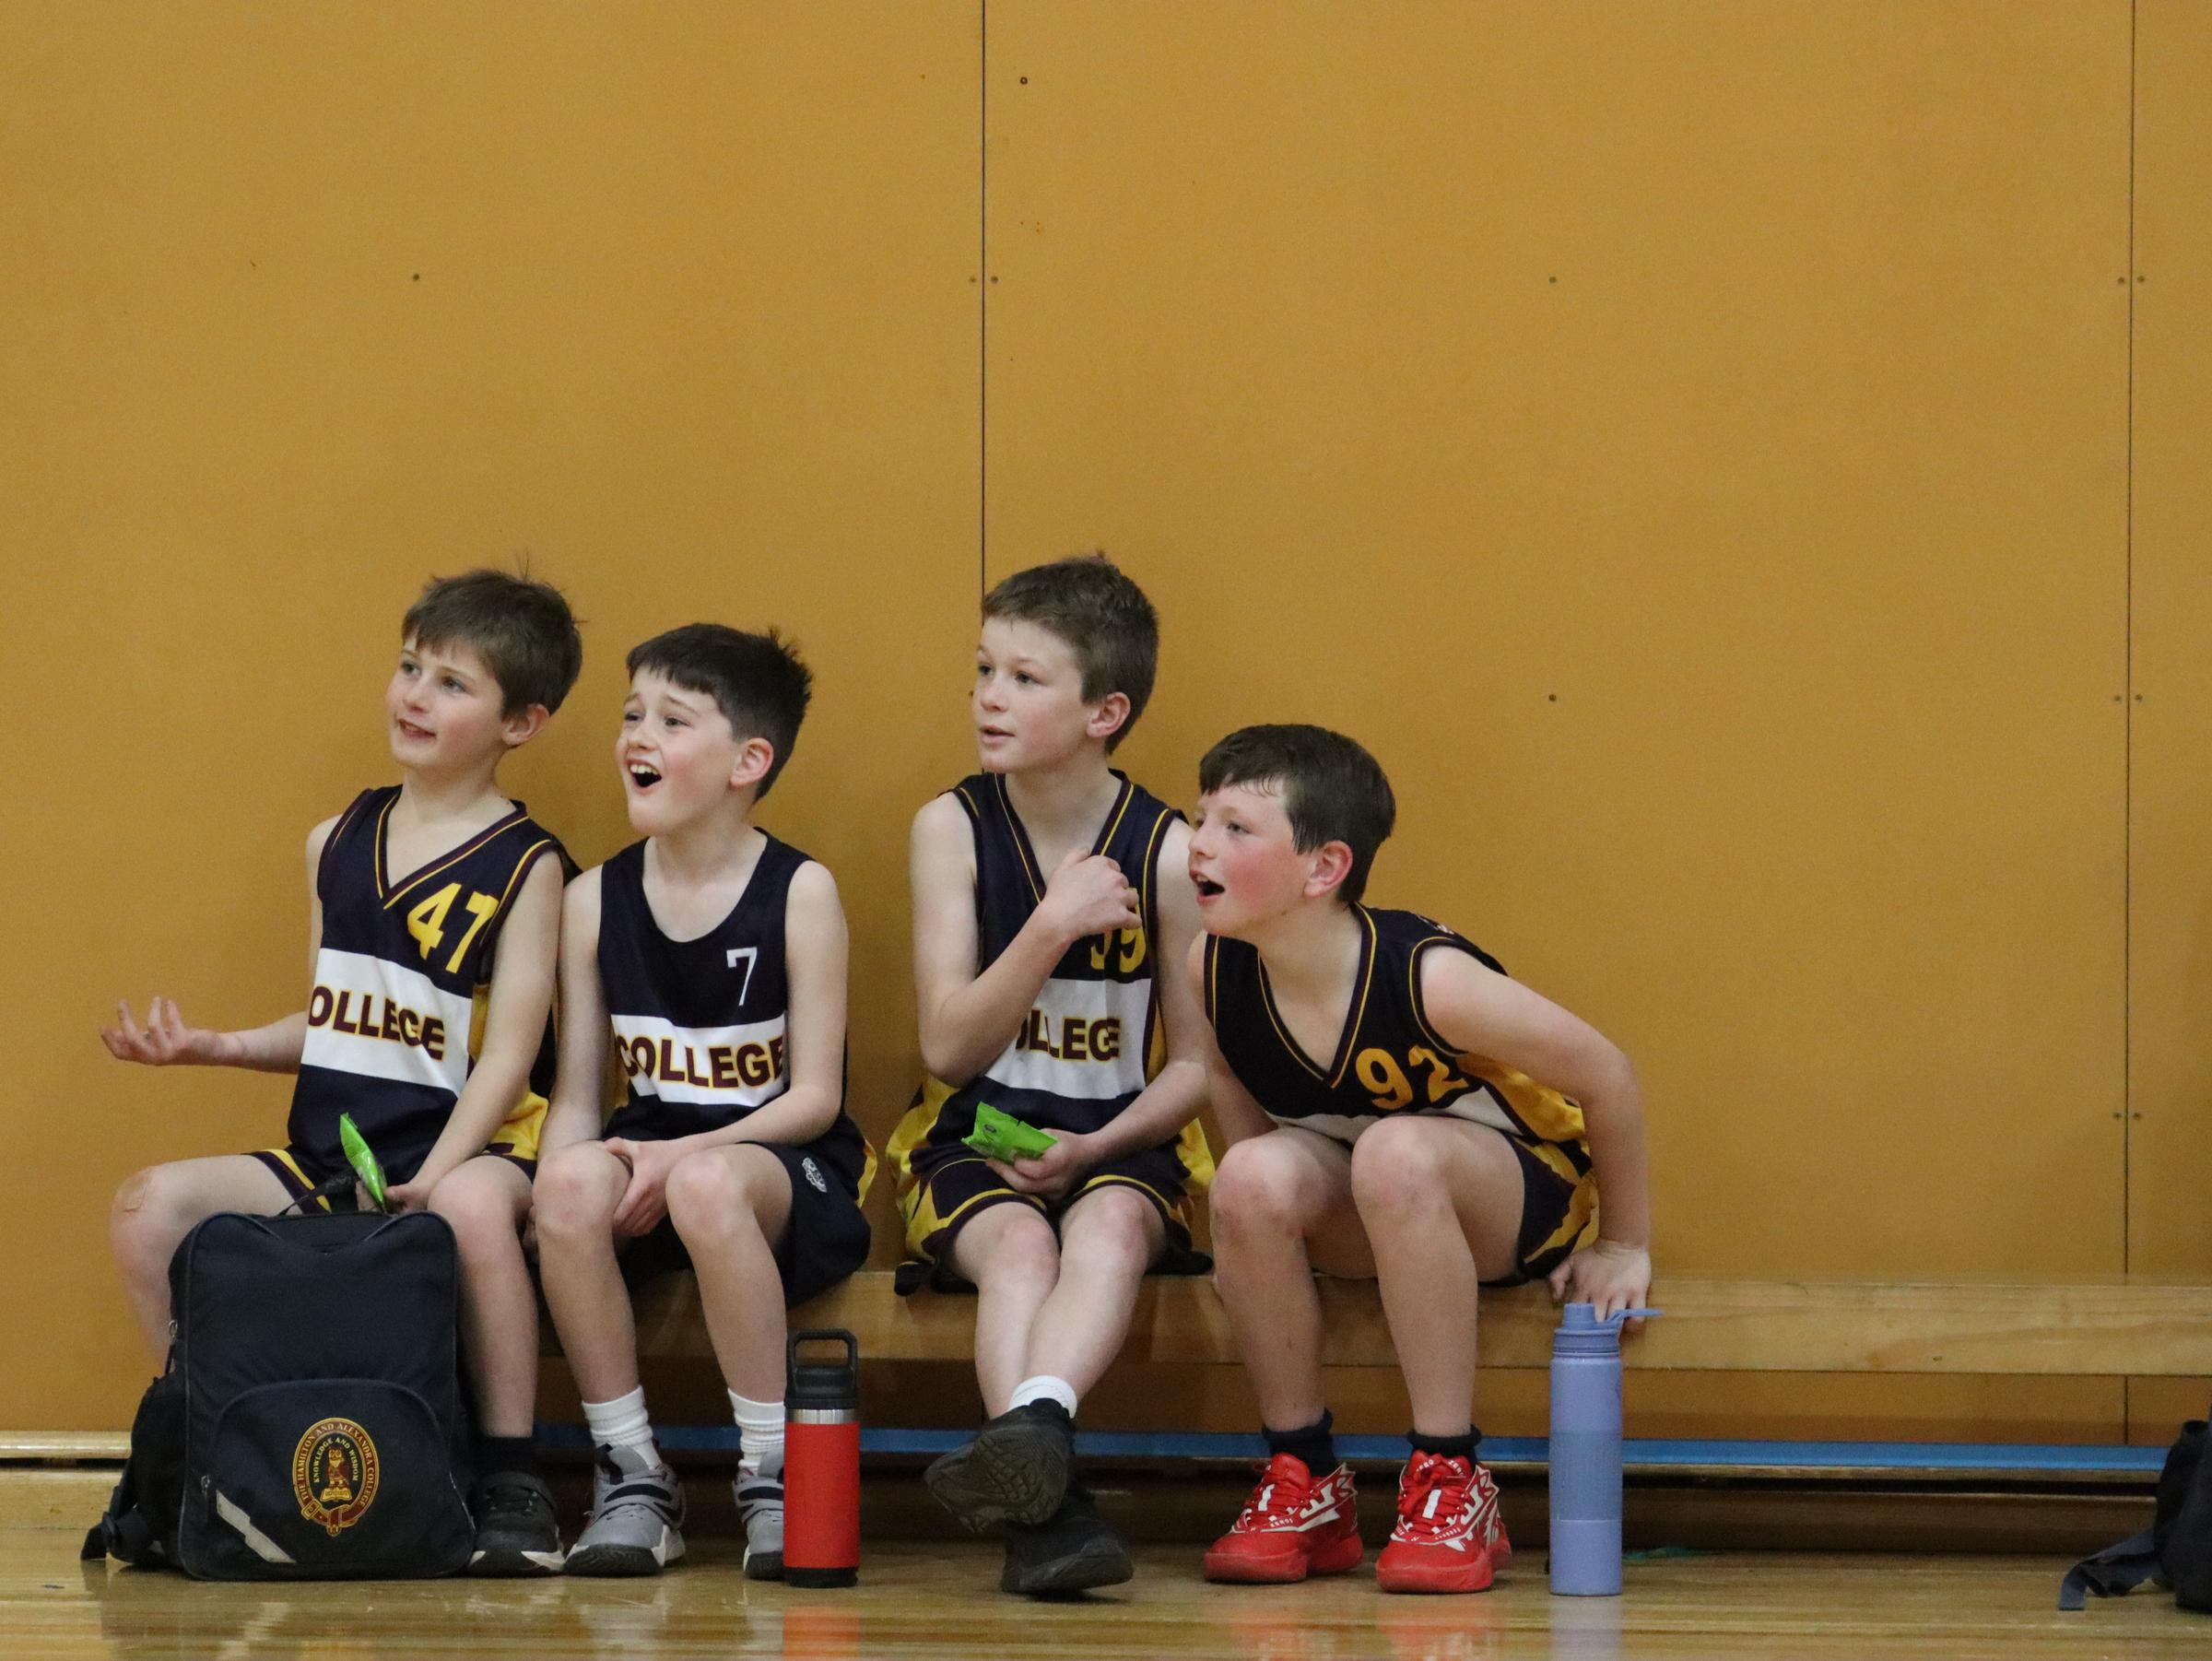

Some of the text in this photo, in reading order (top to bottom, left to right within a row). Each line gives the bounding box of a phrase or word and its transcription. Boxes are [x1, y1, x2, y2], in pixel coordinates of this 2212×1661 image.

[406, 882, 500, 974] 47
[1090, 887, 1147, 973] 9
[726, 946, 758, 1007] 7
[308, 984, 446, 1061] OLLEGE
[1015, 1008, 1122, 1061] LLEG
[615, 1033, 785, 1090] COLLEGE
[1355, 1044, 1469, 1110] 92
[297, 1435, 316, 1480] HAMILTON
[316, 1423, 334, 1435] AND
[337, 1423, 373, 1465] ALEXANDRA
[359, 1467, 375, 1507] COLLEGE
[313, 1437, 359, 1483] KNOWLEDGE AND WISDOM
